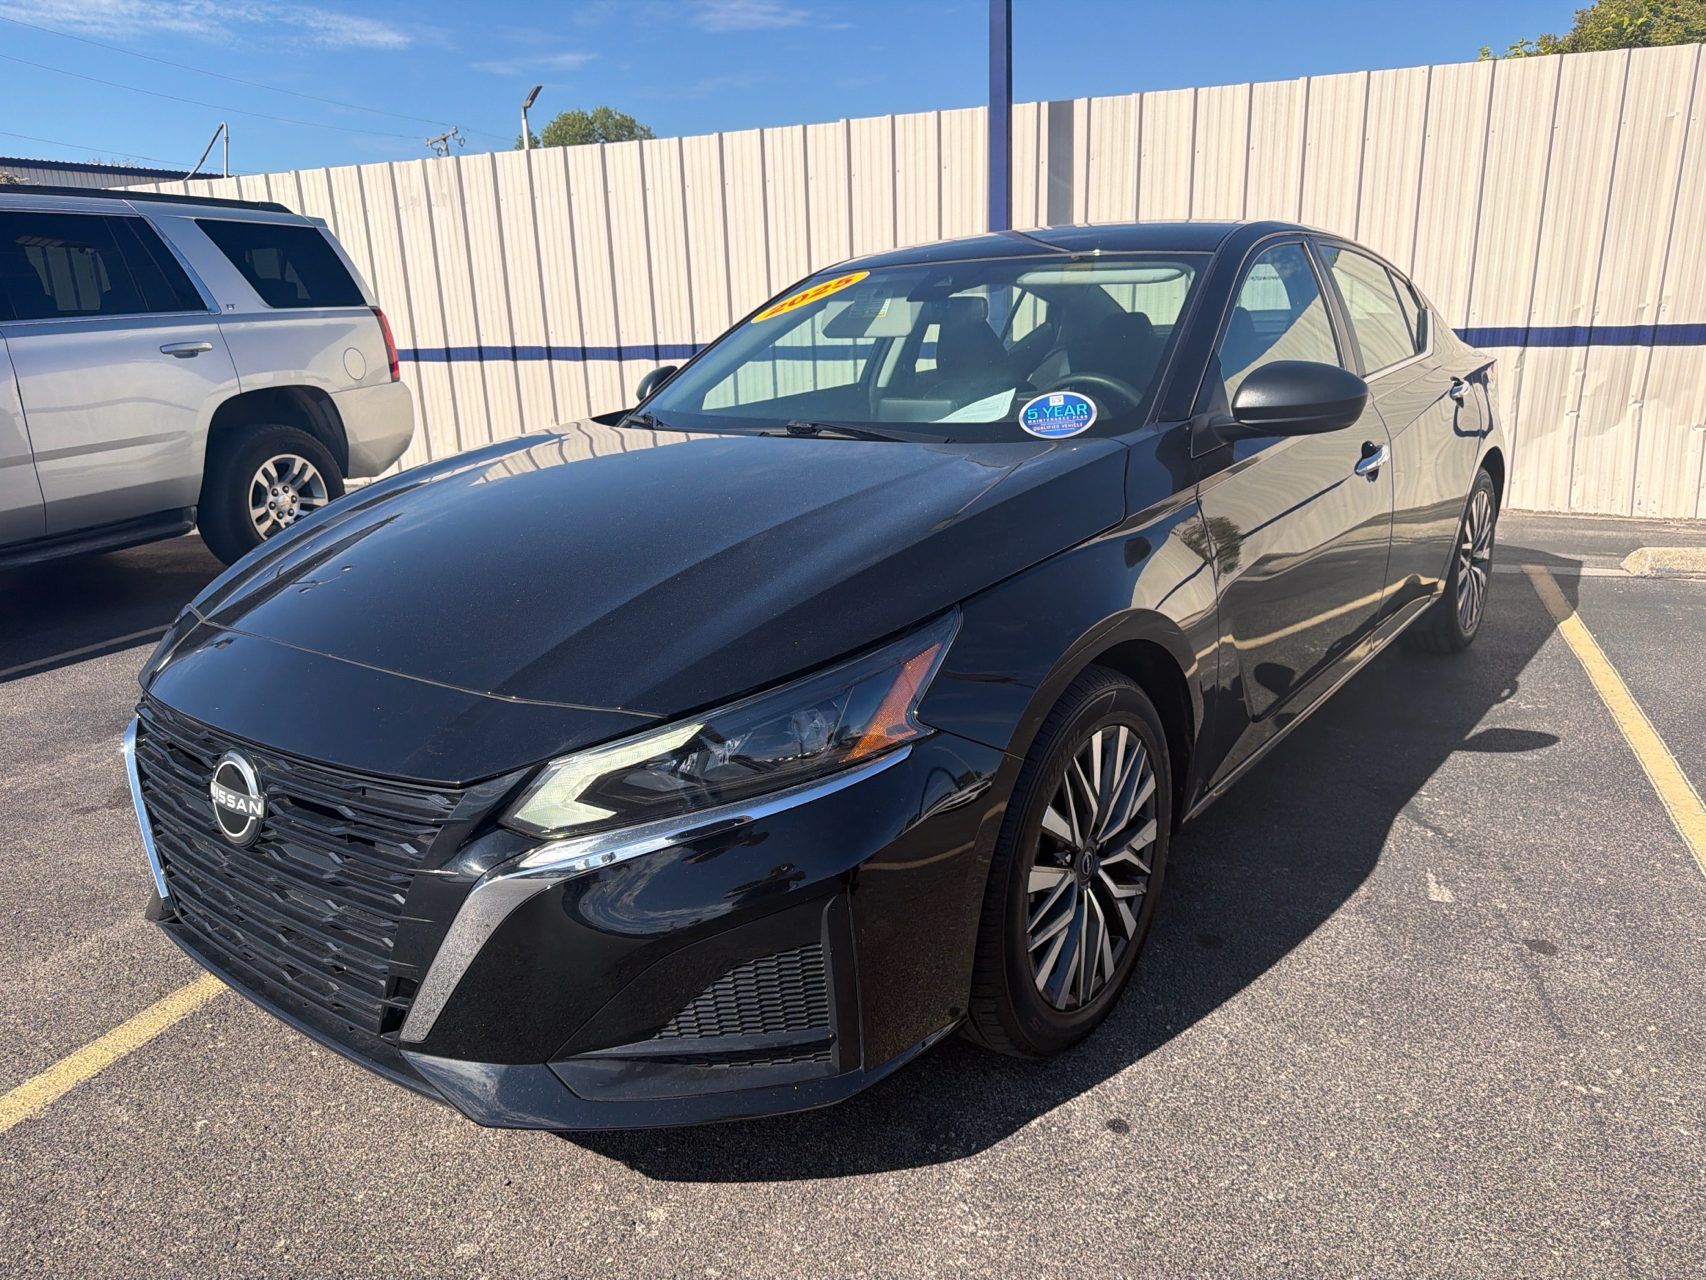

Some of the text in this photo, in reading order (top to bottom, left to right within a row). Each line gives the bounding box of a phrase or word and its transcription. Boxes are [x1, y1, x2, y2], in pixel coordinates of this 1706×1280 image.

[765, 275, 855, 318] 2025
[1027, 403, 1088, 420] 5 YEAR
[1027, 416, 1070, 424] MAINTENANCE
[210, 782, 262, 815] NISSAN
